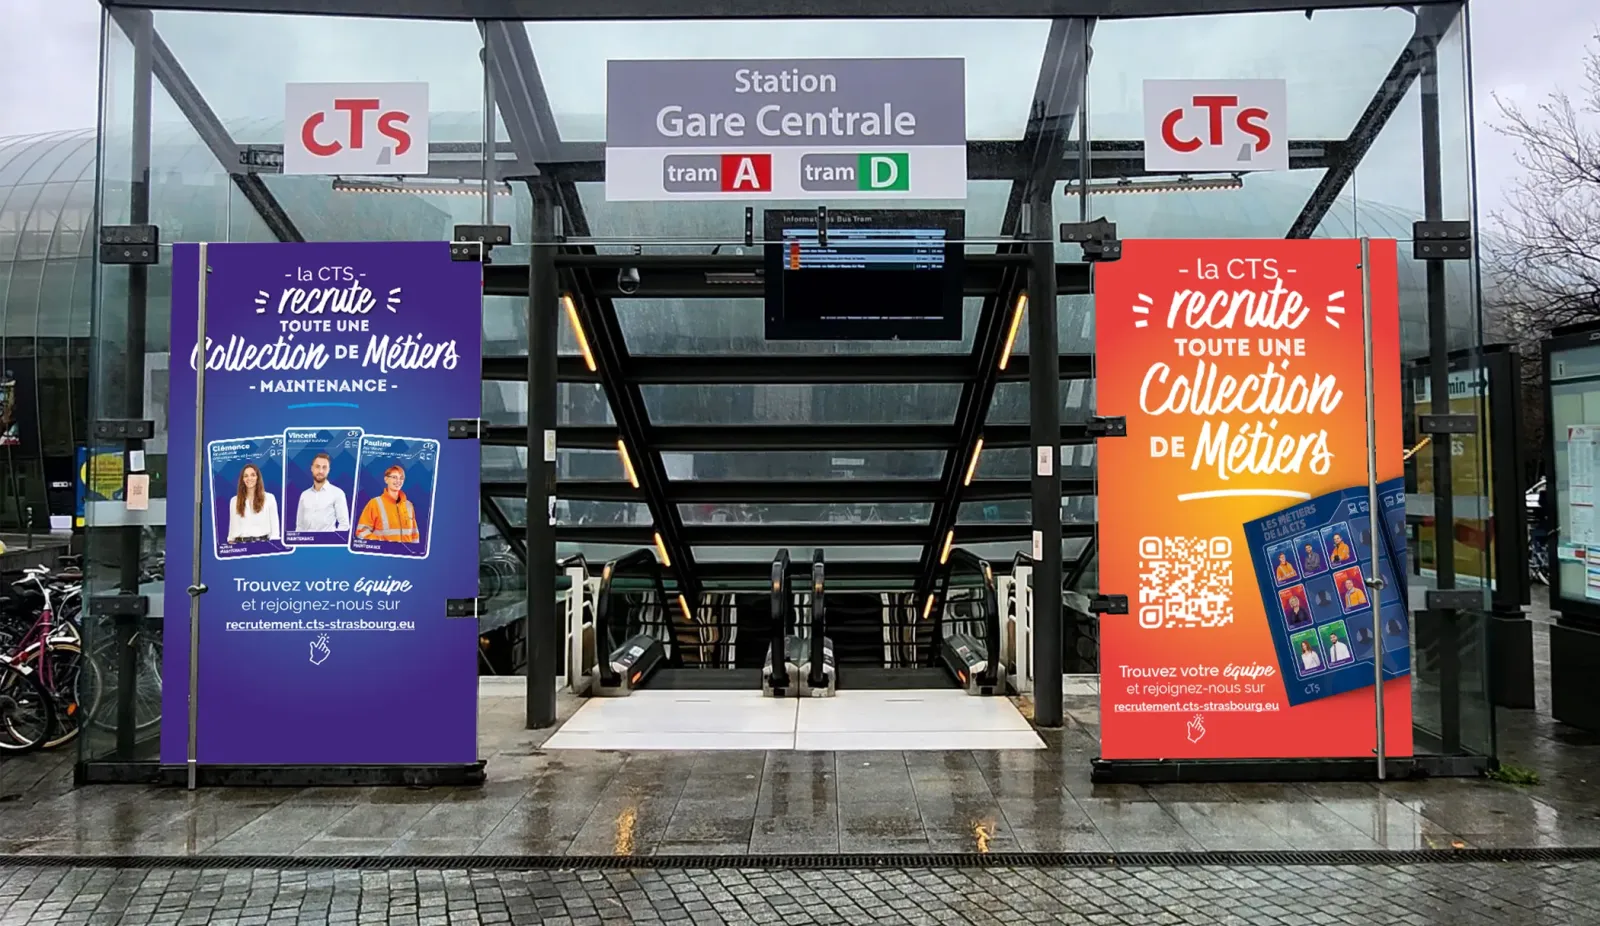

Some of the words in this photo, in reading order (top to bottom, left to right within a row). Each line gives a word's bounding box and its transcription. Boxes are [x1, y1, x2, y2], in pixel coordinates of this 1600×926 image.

[735, 69, 837, 93] Station
[301, 98, 412, 157] CTS
[656, 105, 745, 137] Gare
[756, 102, 917, 136] Centrale
[1161, 95, 1272, 153] CTS
[667, 164, 718, 182] tram
[732, 156, 761, 189] A
[805, 162, 855, 181] tram
[870, 156, 899, 188] D
[836, 215, 852, 223] Bus
[853, 215, 872, 223] Tram
[297, 266, 313, 281] la
[318, 266, 354, 281] CTS
[1197, 257, 1219, 280] la
[1226, 257, 1279, 280] CTS
[277, 279, 376, 314] recrute
[1166, 277, 1310, 330] recrute
[280, 320, 331, 332] TOUTE
[336, 320, 369, 332] UNE
[190, 333, 330, 371] Collection
[335, 344, 359, 359] DE
[362, 332, 461, 373] Métiers
[1174, 338, 1250, 357] TOUTE
[1258, 338, 1306, 357] UNE
[260, 379, 387, 392] MAINTENANCE
[1139, 358, 1344, 416] Collection
[212, 443, 250, 452] Clémence
[363, 439, 392, 448] Pauline
[1150, 436, 1185, 458] DE
[1190, 418, 1335, 481] Métiers
[1260, 518, 1278, 532] LES
[1263, 530, 1277, 542] DE
[1276, 525, 1290, 537] LA
[1289, 518, 1307, 533] CTS
[233, 577, 301, 592] Trouvez
[305, 578, 350, 592] votre
[353, 575, 413, 596] équipe
[241, 598, 257, 611] et
[261, 598, 373, 614] rejoignez-nous
[377, 600, 401, 611] sur
[226, 619, 415, 631] recrutement.cts-strasbourg.eu
[1119, 665, 1177, 678] Trouvez
[1181, 664, 1220, 678] votre
[1223, 661, 1276, 681] équipe
[1126, 682, 1140, 695] et
[1143, 682, 1241, 697] rejoignez-nous
[1244, 682, 1266, 694] sur
[1113, 701, 1280, 713] recrutement.cts-strasbourg.eu
